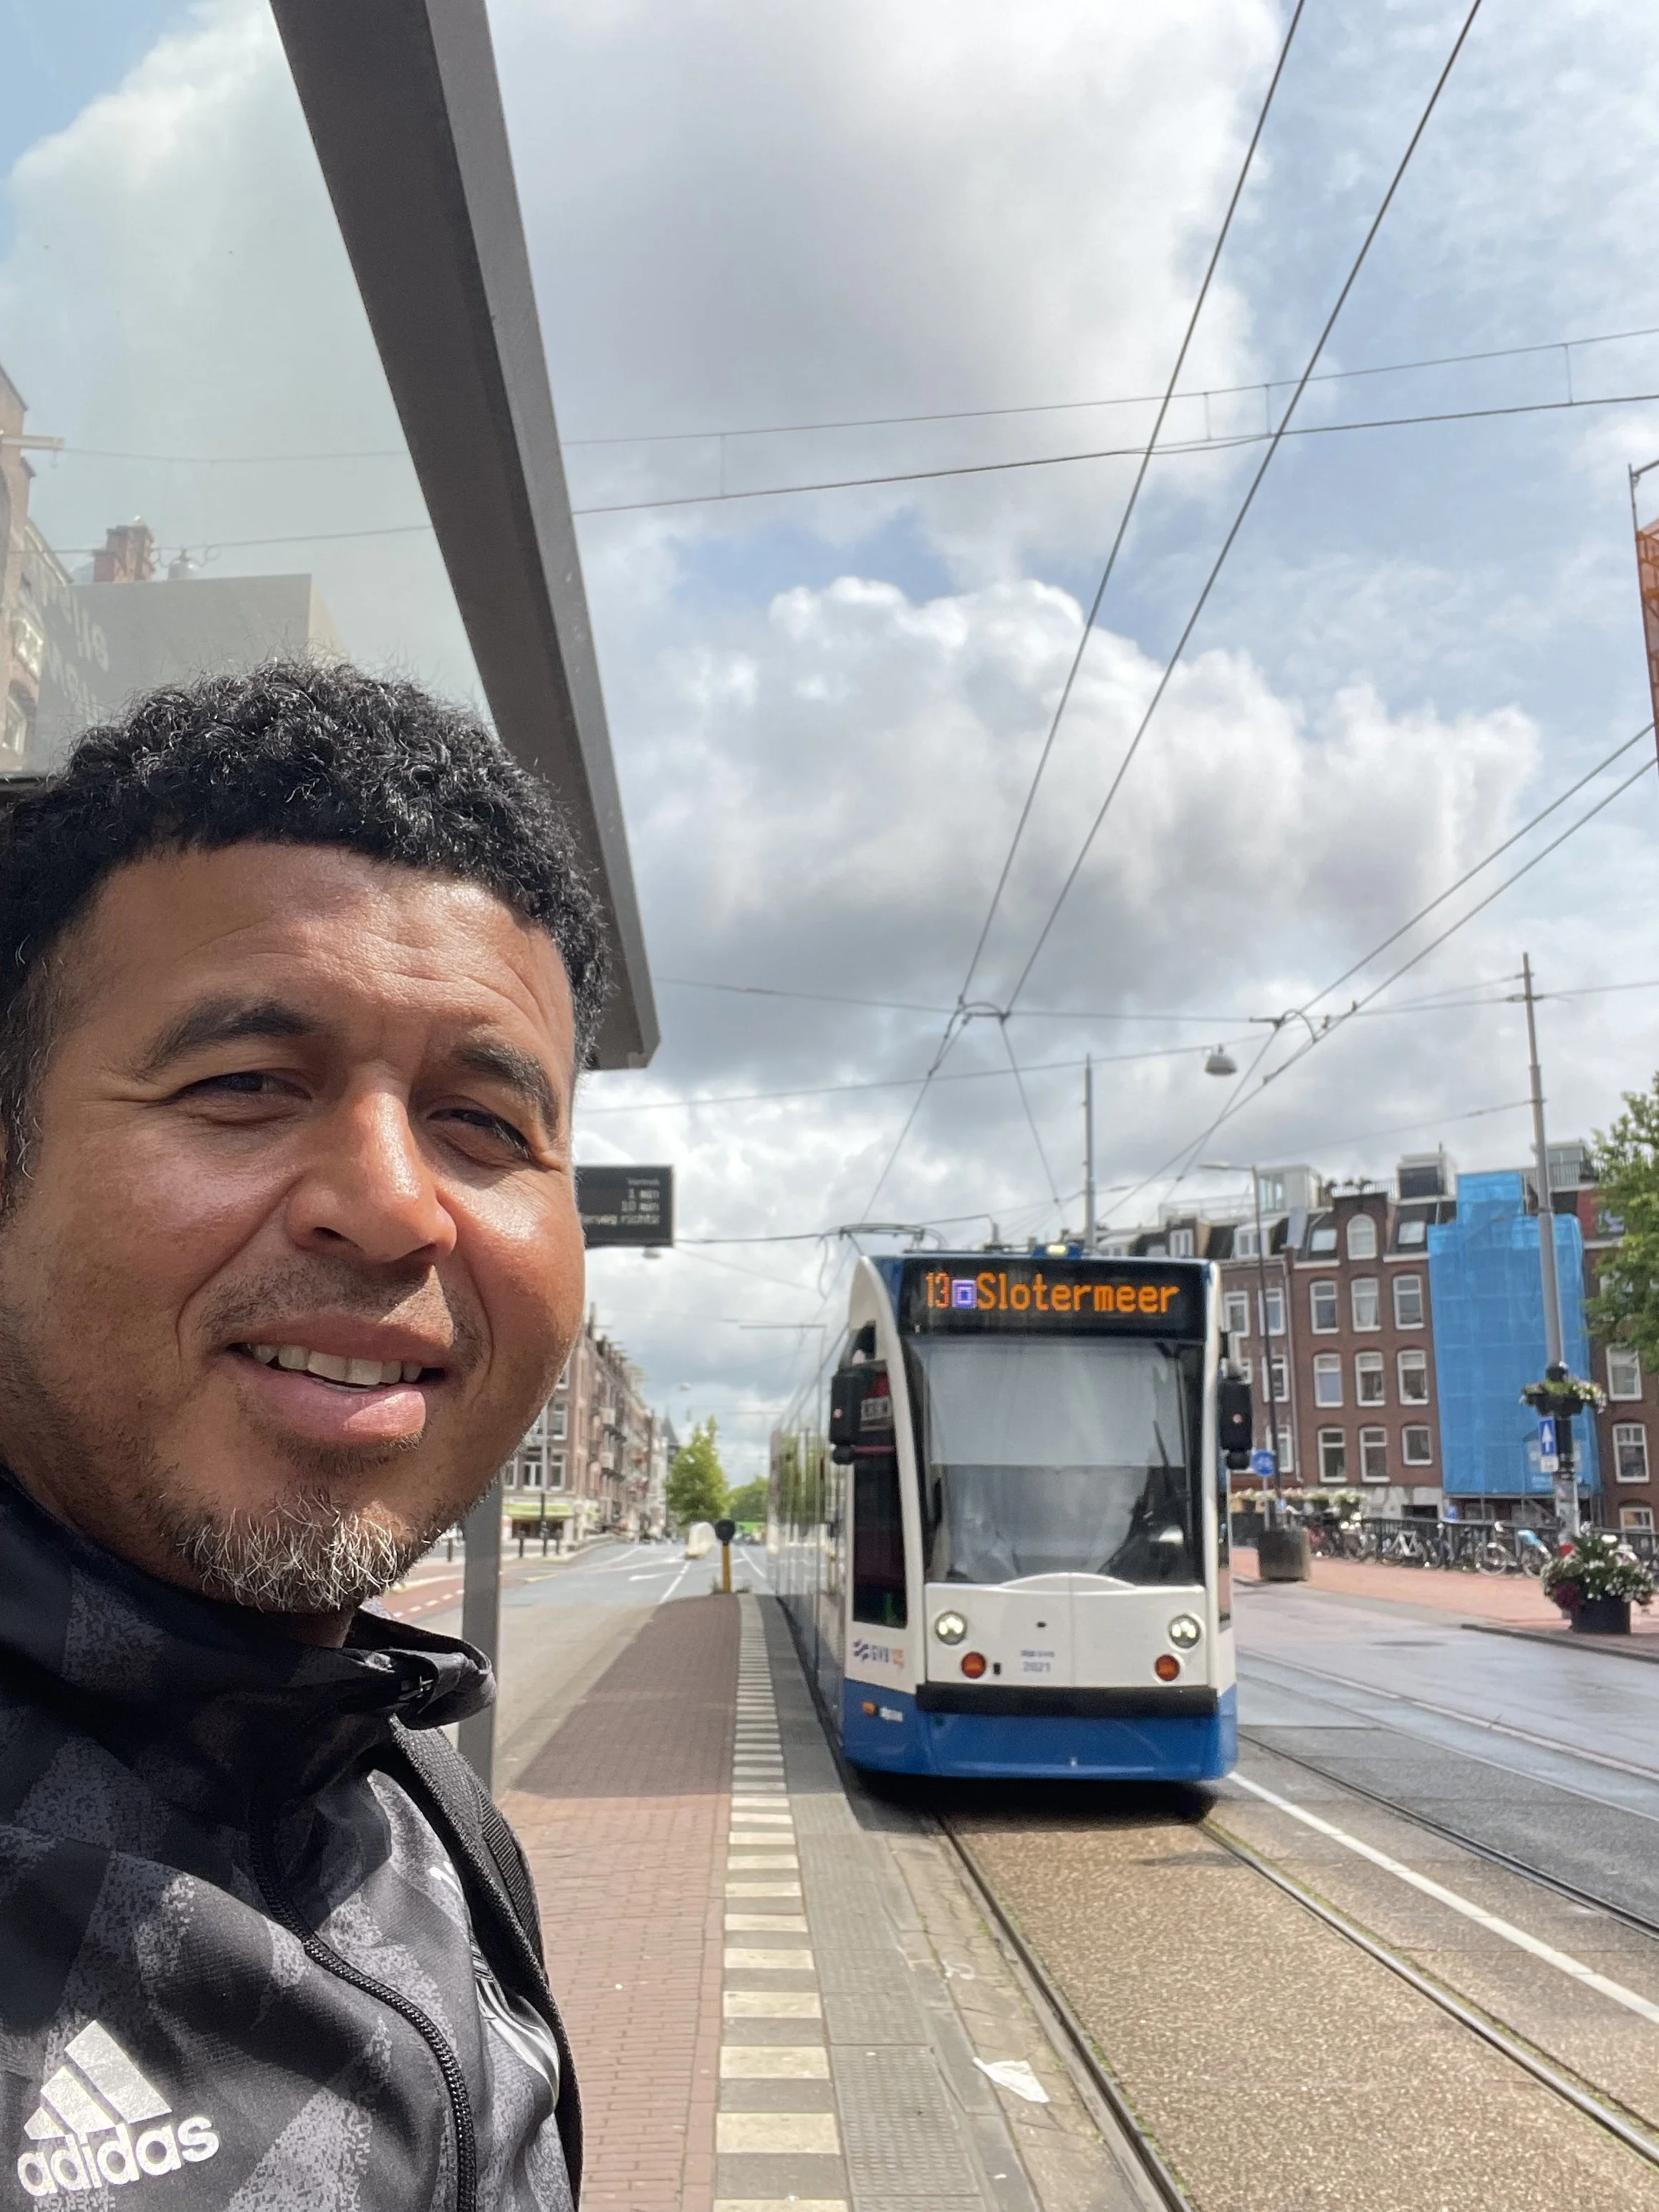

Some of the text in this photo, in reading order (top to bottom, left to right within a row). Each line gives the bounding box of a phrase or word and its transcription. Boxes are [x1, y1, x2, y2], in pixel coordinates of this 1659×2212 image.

[925, 1271, 1180, 1313] 13 Slotermeer
[17, 2117, 219, 2196] adidas
